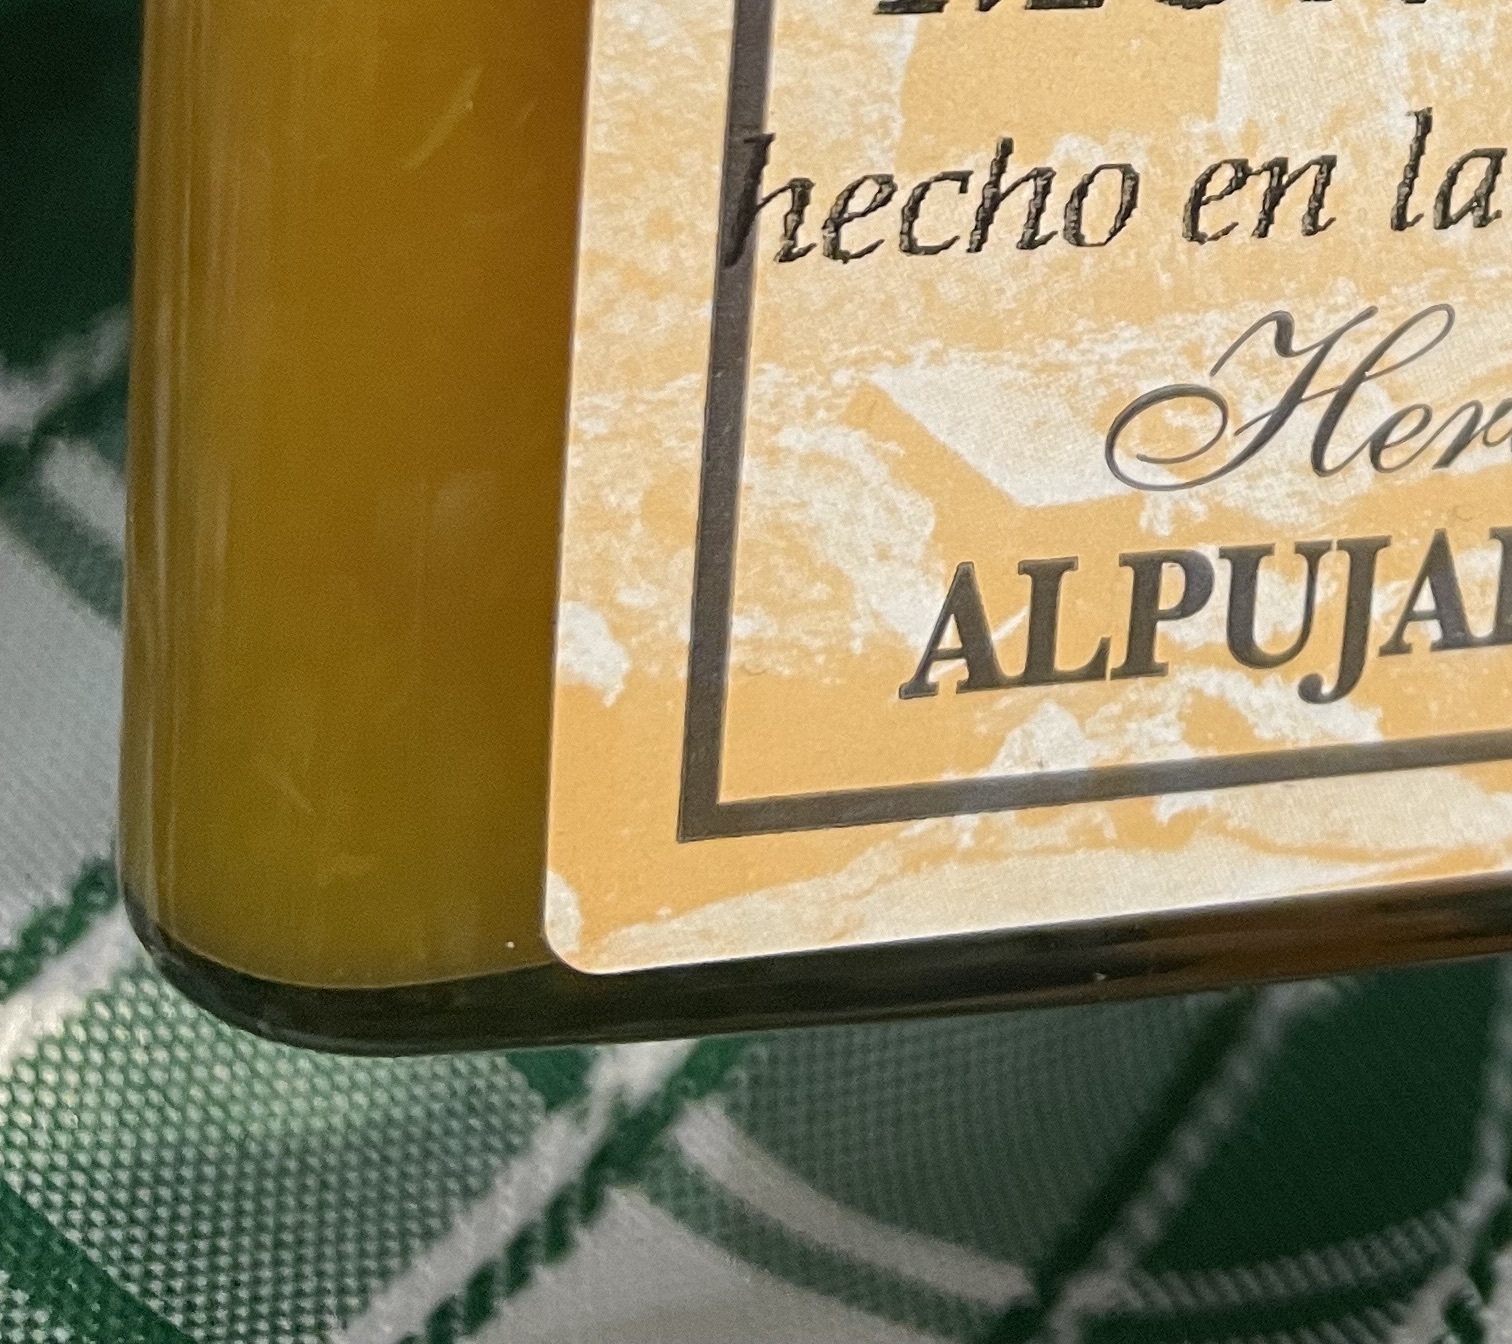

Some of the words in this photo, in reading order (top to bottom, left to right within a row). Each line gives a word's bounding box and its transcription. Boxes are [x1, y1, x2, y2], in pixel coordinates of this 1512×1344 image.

[722, 132, 1140, 268] hecho
[1182, 154, 1337, 244] en
[1391, 107, 1507, 230] la
